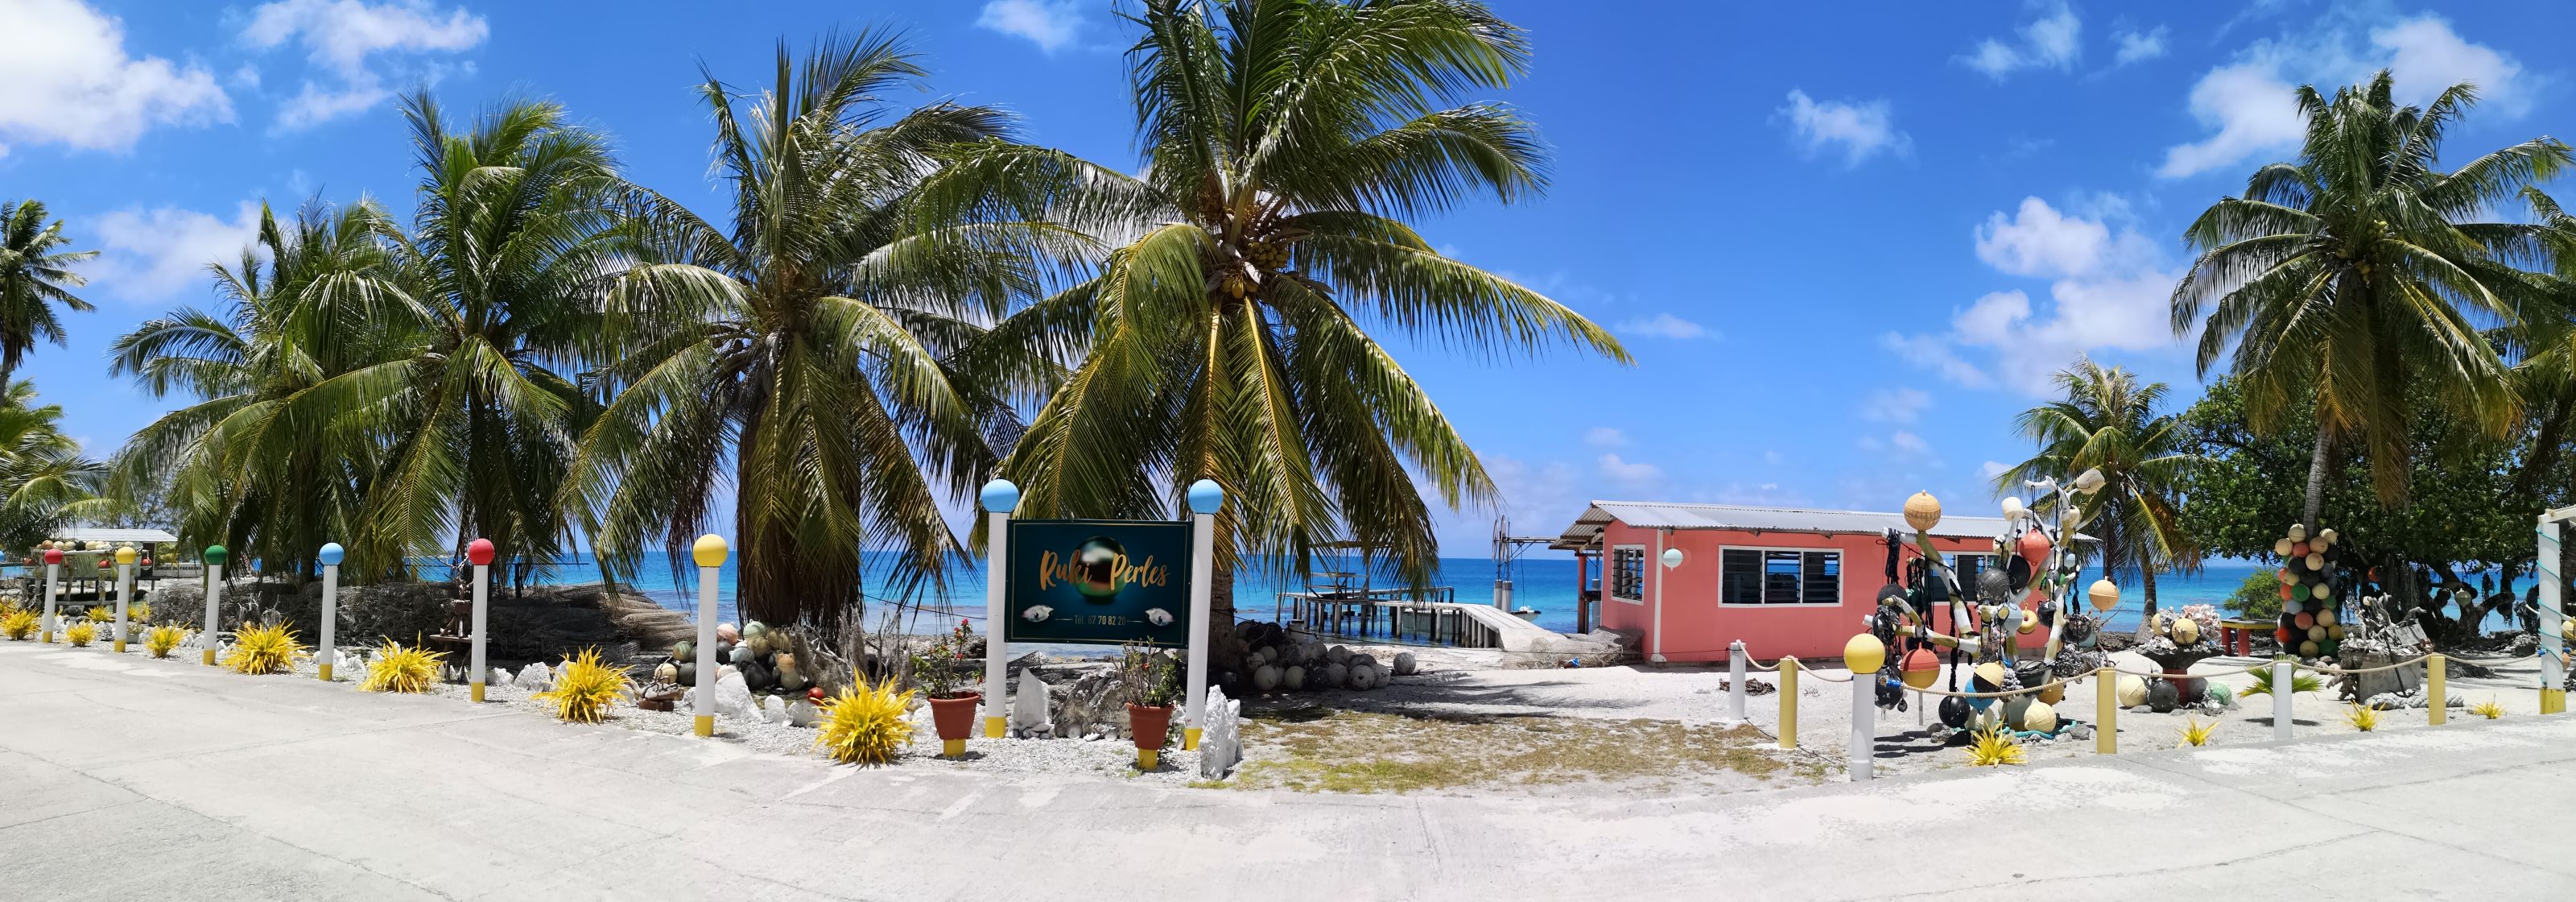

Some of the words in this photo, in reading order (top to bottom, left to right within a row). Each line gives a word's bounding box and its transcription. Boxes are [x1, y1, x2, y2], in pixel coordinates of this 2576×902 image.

[1040, 549, 1092, 591] Ruki
[1110, 552, 1170, 591] Perles
[1098, 615, 1107, 625] 70
[1108, 615, 1117, 626] 82
